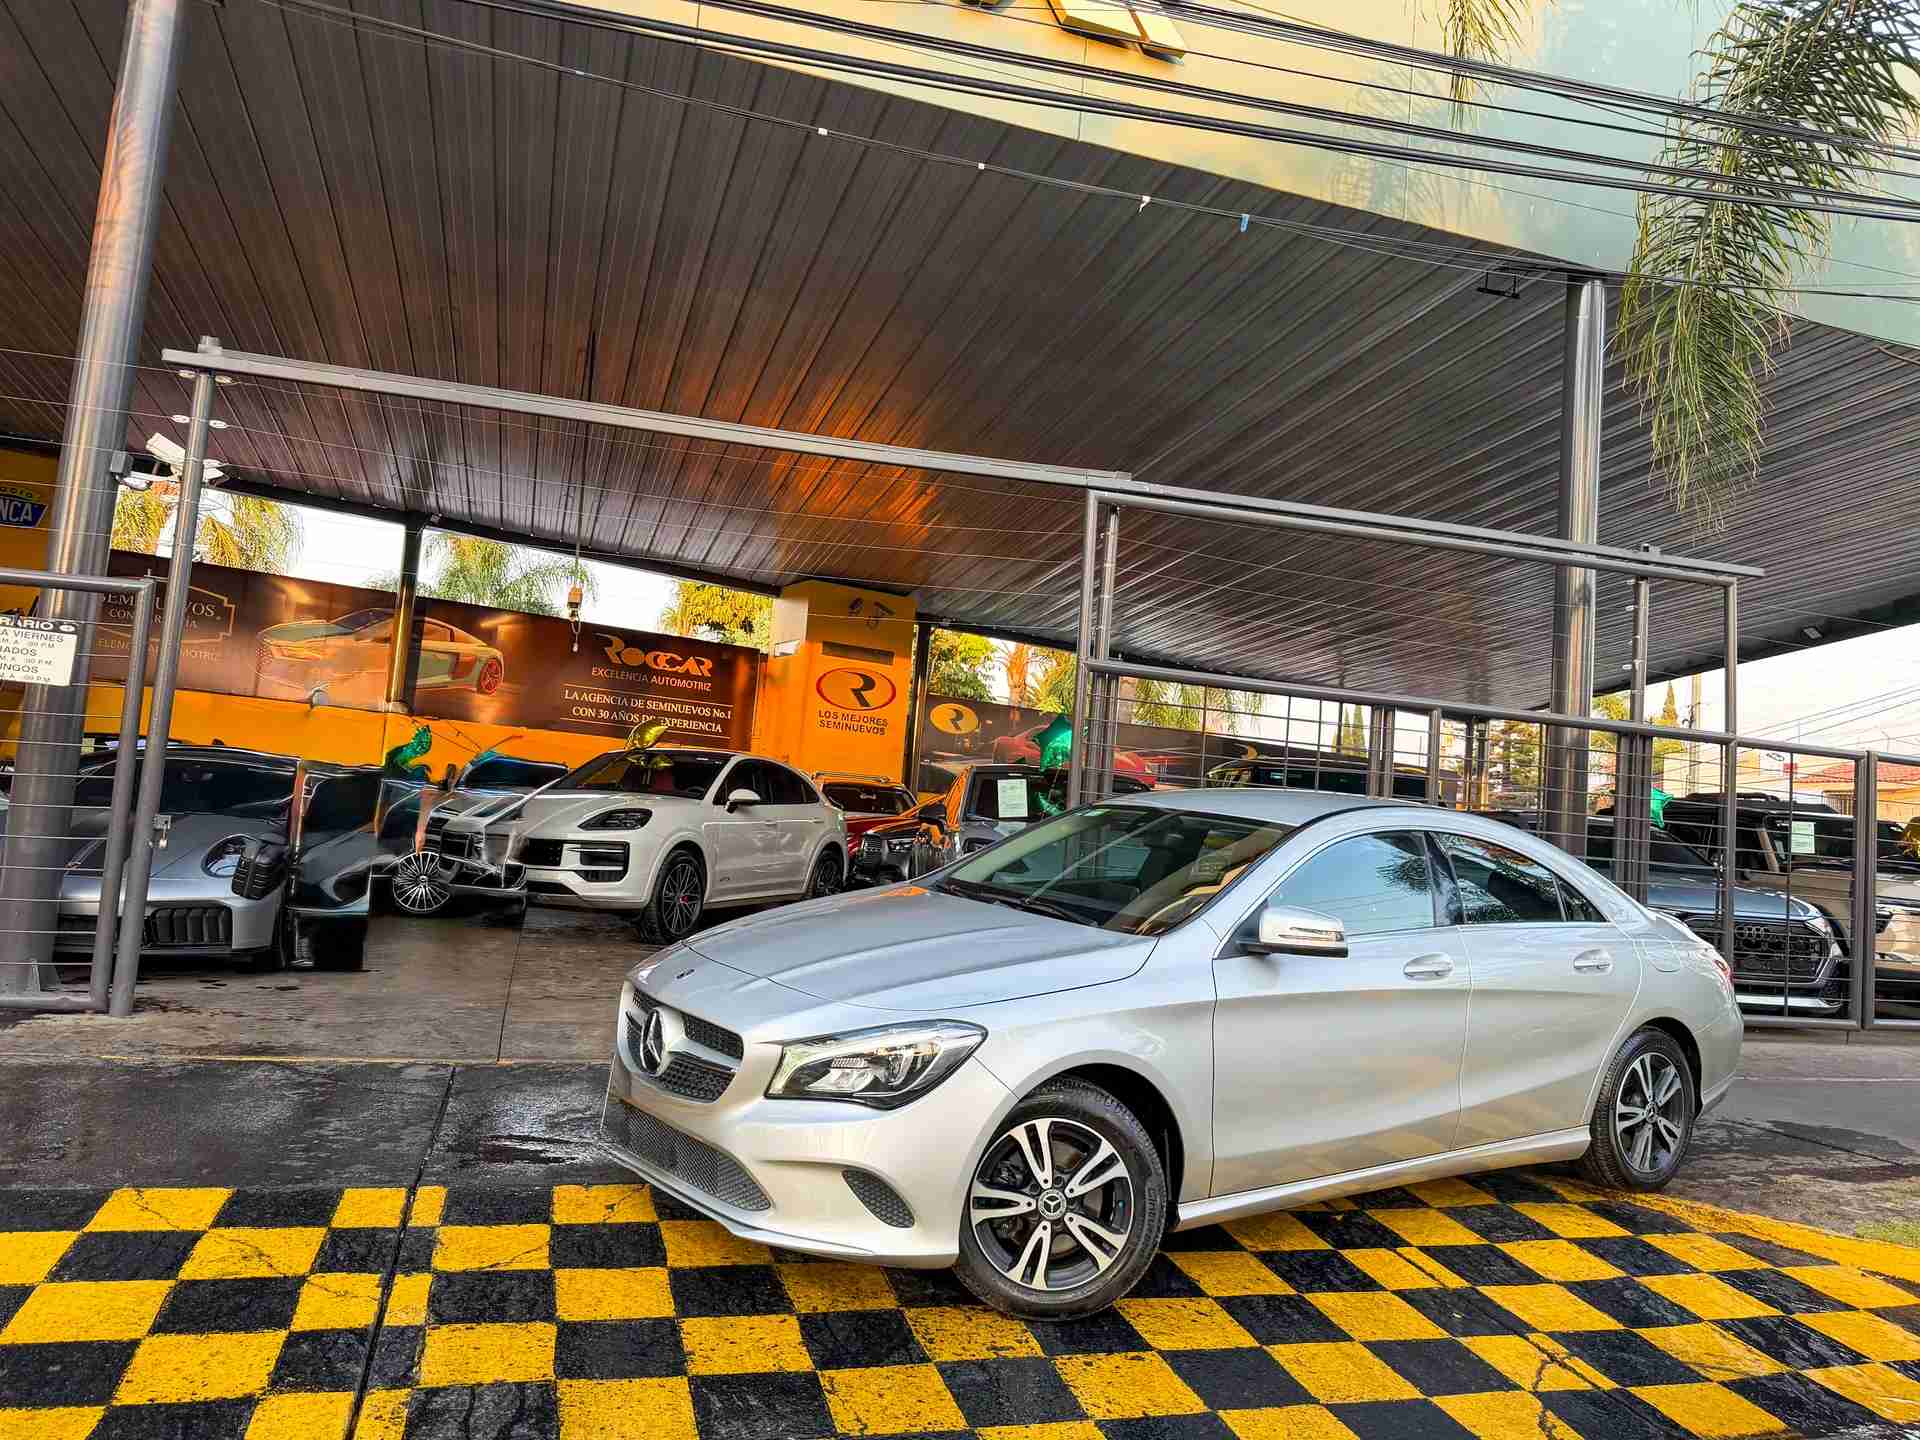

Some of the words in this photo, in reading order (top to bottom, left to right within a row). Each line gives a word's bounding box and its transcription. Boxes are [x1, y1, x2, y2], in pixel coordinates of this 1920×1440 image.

[14, 629, 65, 643] VIERNES
[593, 632, 713, 677] ROCCAR
[592, 666, 649, 682] EXCELENCIA
[650, 674, 712, 692] AUTOMOTRIZ
[565, 690, 579, 701] LA
[580, 692, 629, 707] AGENCIA
[630, 698, 646, 709] DE
[646, 700, 711, 718] SEMINUEVOS
[572, 706, 596, 718] CON
[598, 709, 610, 720] 30
[611, 709, 639, 723] AÑOS
[818, 710, 838, 720] LOS
[841, 712, 889, 728] MEJORES
[818, 720, 887, 735] SEMINUEVOS
